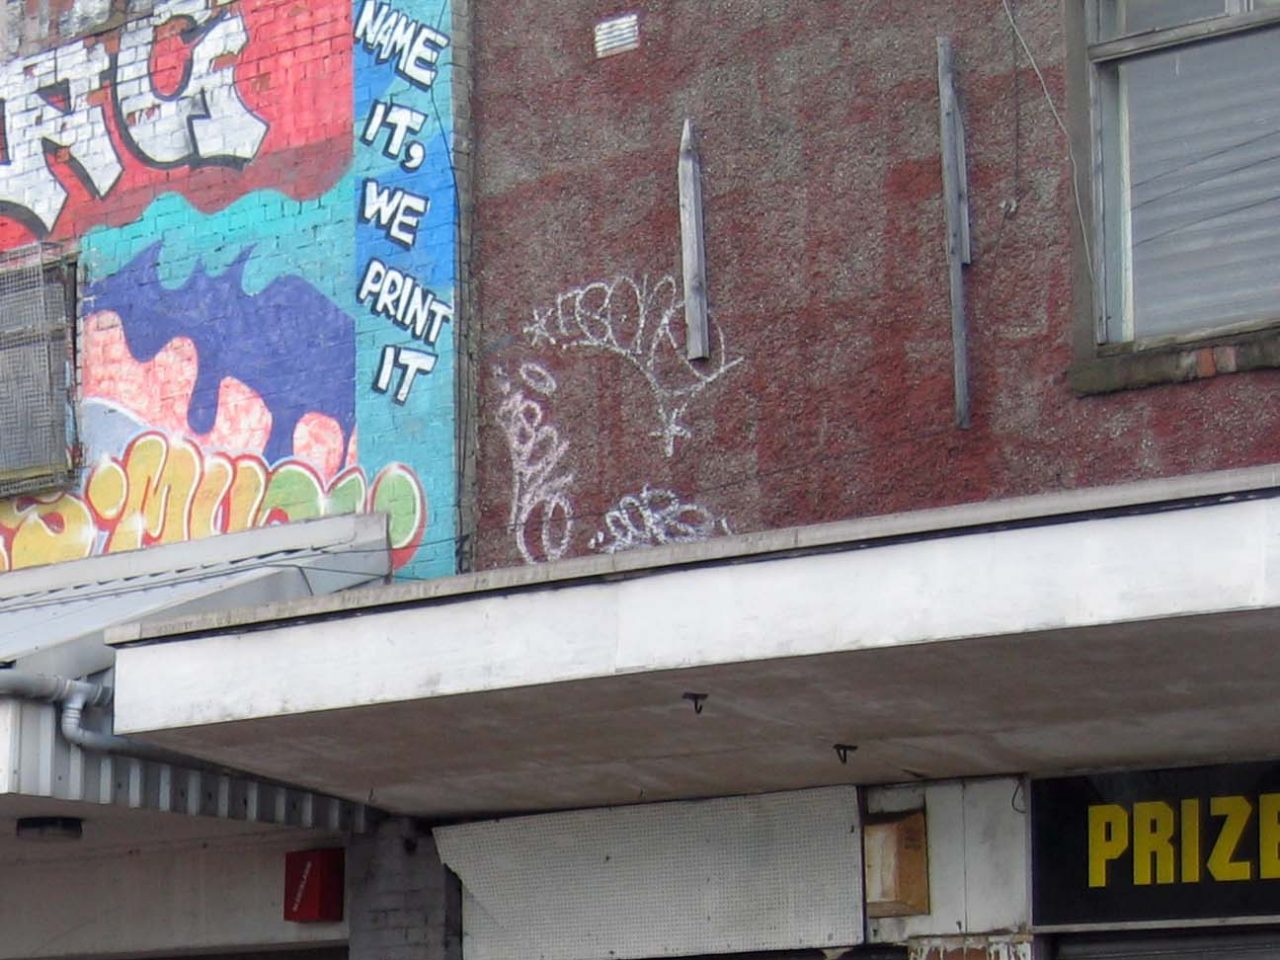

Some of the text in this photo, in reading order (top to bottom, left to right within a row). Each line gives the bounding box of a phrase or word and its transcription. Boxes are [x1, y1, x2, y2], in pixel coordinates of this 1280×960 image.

[355, 0, 449, 88] NAME
[363, 181, 429, 247] WE
[360, 259, 453, 343] PRINT
[377, 345, 437, 402] IT
